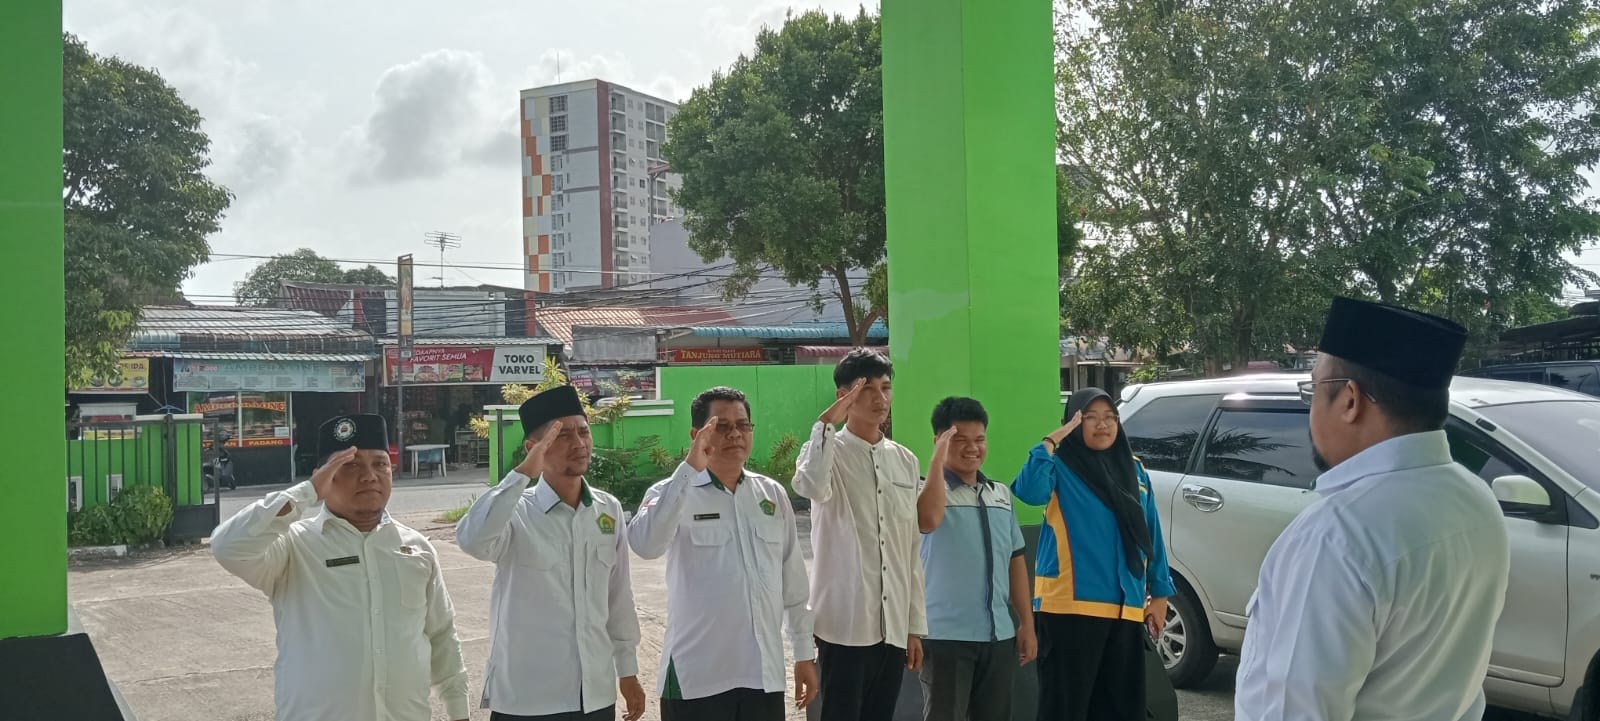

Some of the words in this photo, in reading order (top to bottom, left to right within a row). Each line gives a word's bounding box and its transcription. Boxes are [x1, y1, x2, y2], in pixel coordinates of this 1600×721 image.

[442, 352, 467, 361] SEMUA
[503, 354, 535, 364] TOKO
[681, 350, 720, 359] TANJUNG
[722, 349, 761, 359] MUTIARA
[498, 365, 541, 375] VARVEL
